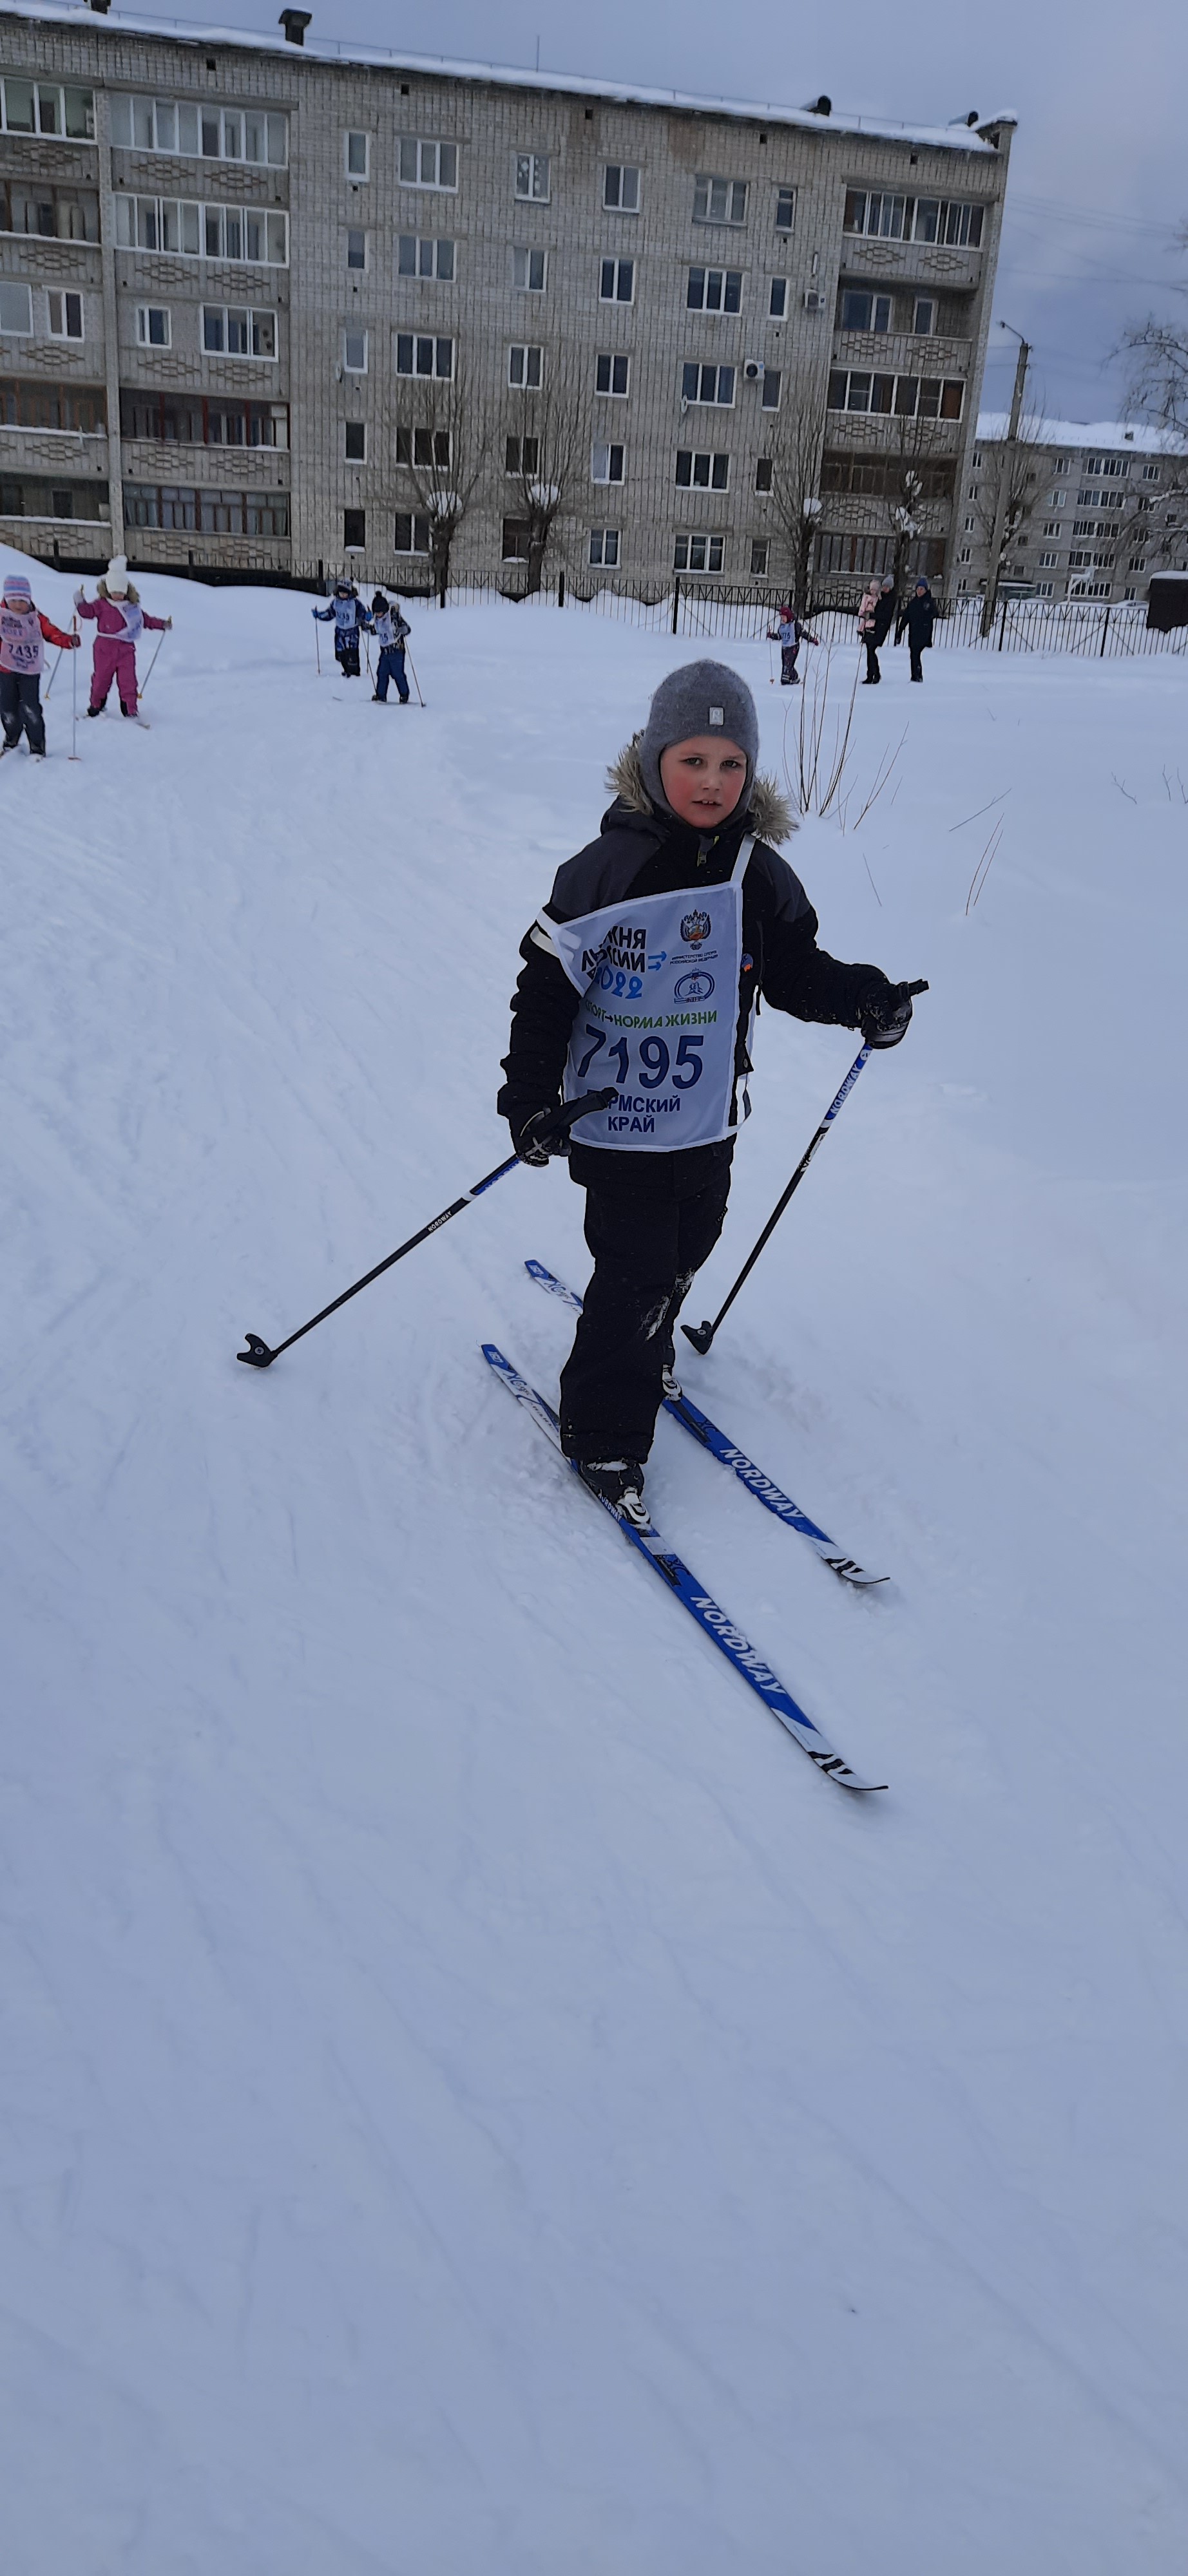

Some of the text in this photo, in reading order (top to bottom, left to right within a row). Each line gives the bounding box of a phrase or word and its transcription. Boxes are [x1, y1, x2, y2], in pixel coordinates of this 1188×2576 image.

[614, 1014, 663, 1029] НОРМА
[666, 1010, 717, 1027] ЖИЗНИ
[577, 1024, 704, 1090] 7195
[830, 1063, 862, 1114] NORDWAY
[608, 1114, 655, 1133] КРАЙ
[427, 1211, 452, 1232] NORDWAY
[719, 1448, 806, 1518] NORDWAY
[689, 1597, 788, 1694] NORDWAY
